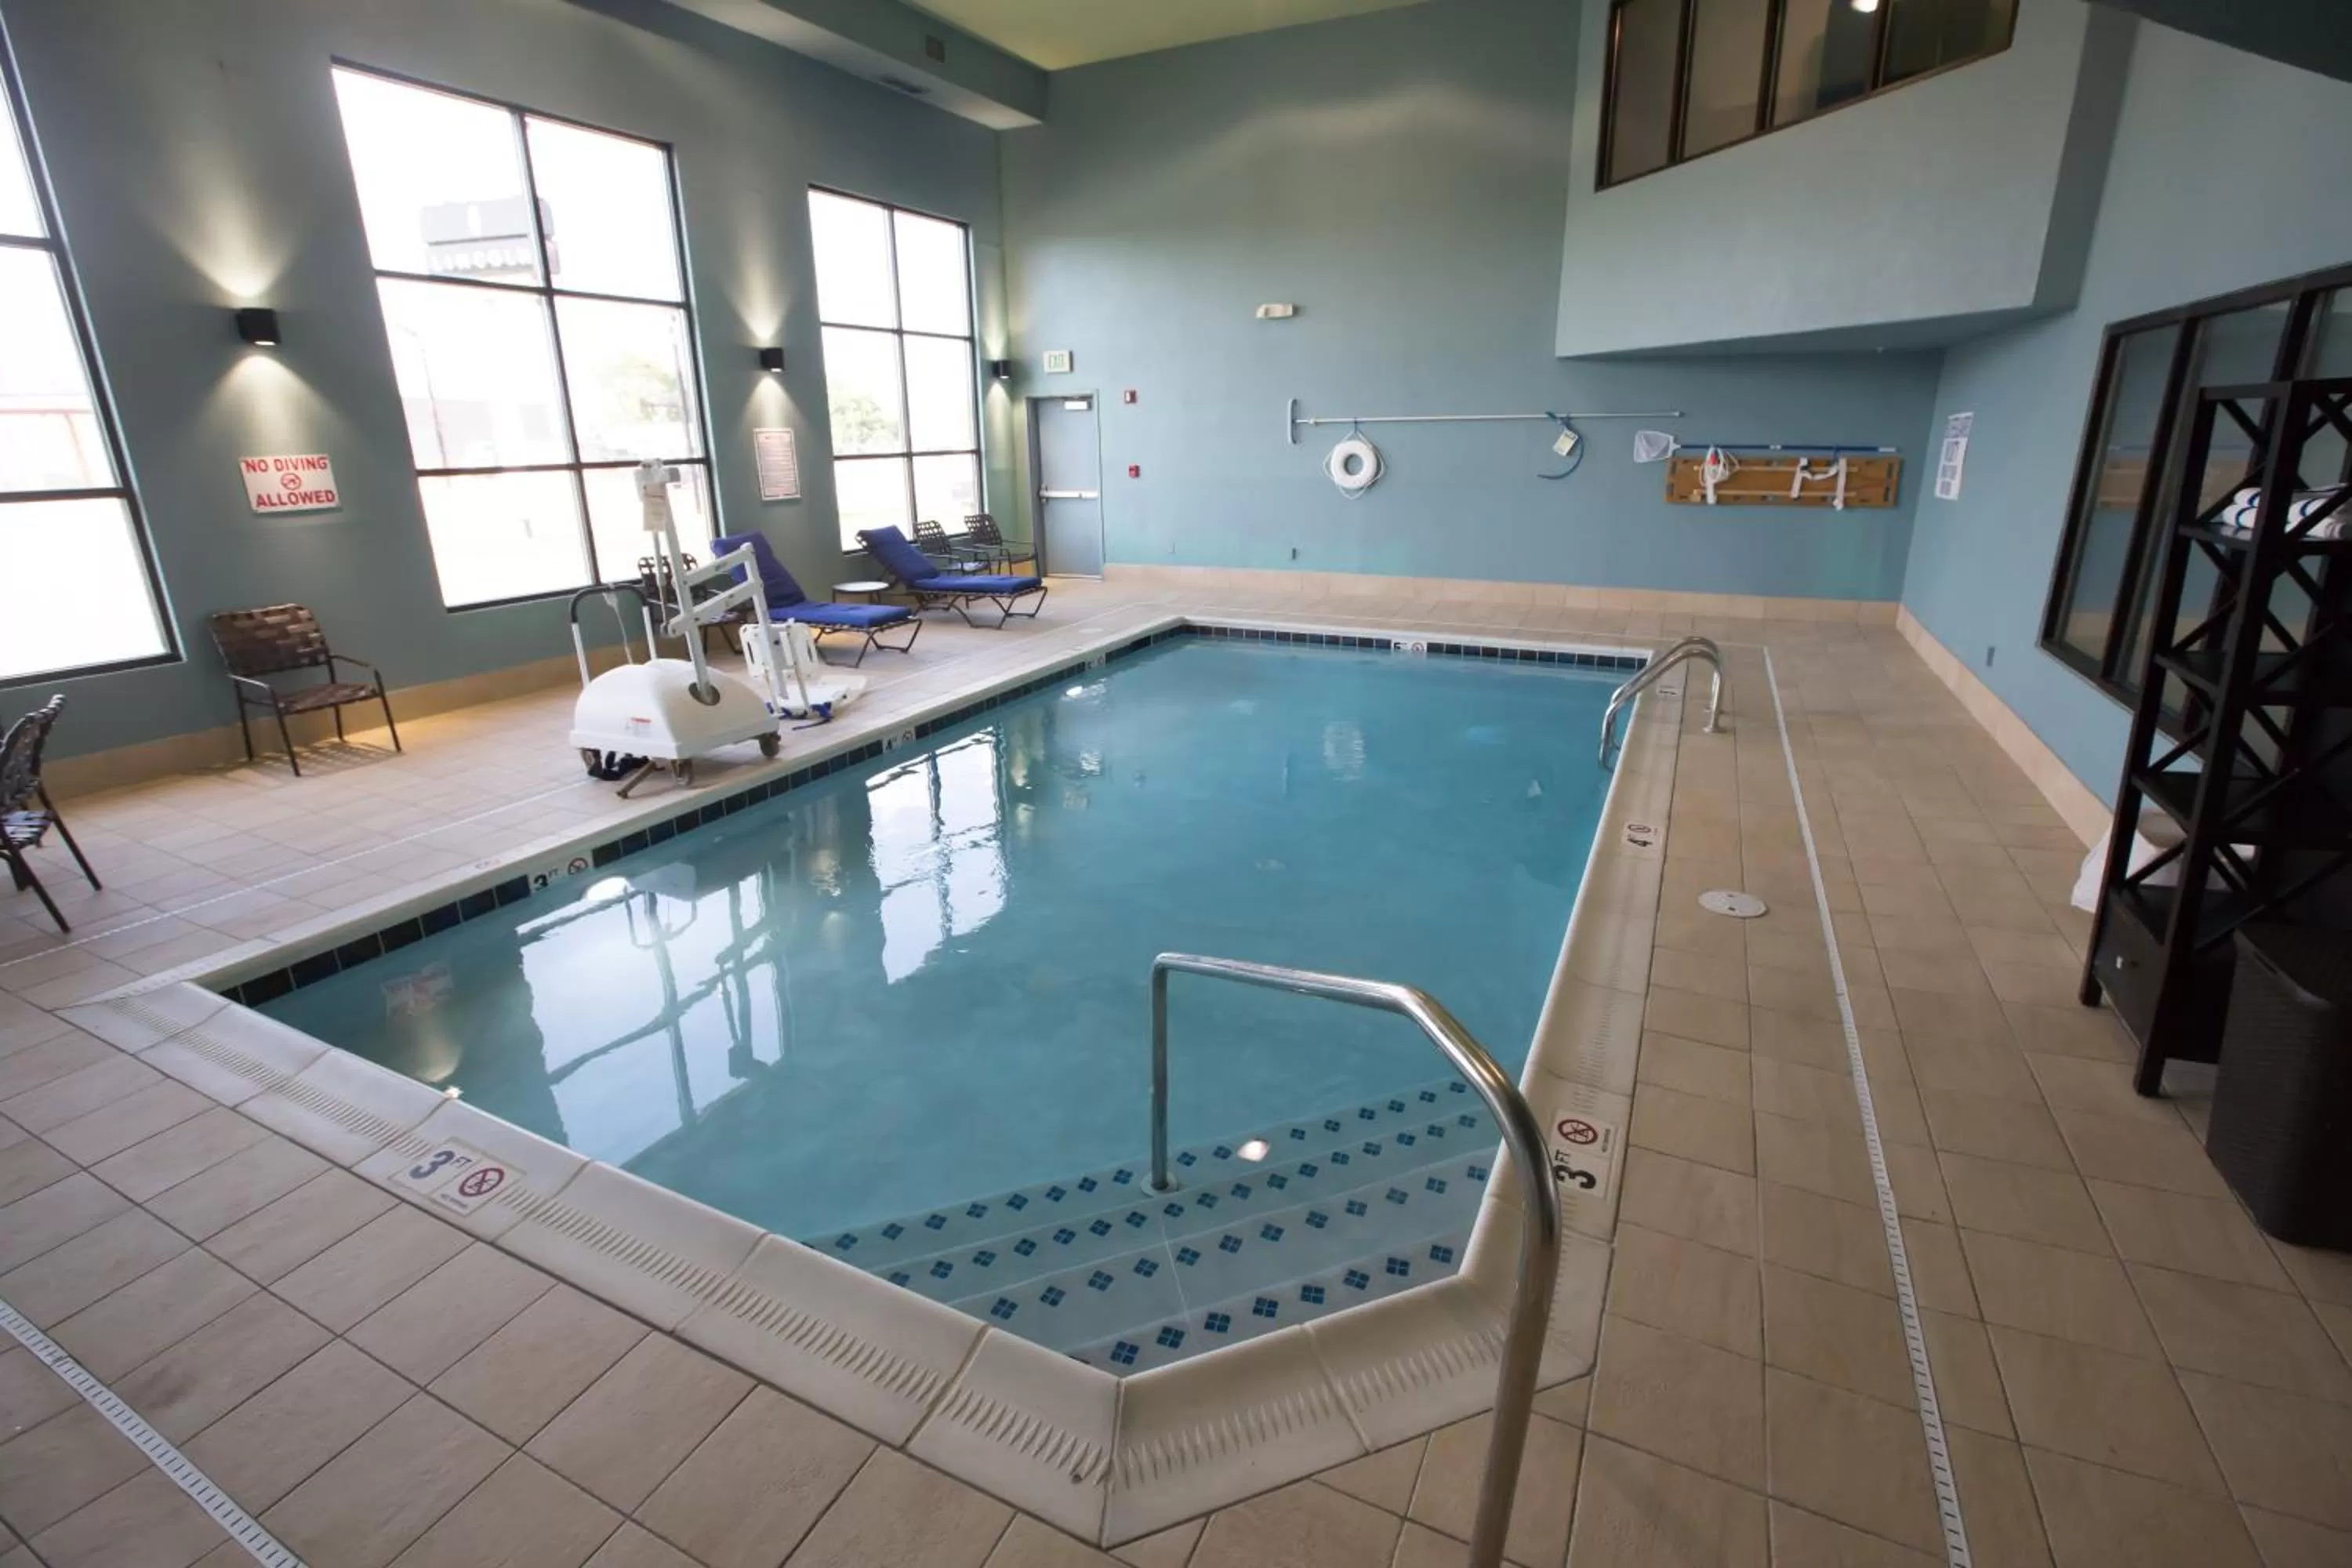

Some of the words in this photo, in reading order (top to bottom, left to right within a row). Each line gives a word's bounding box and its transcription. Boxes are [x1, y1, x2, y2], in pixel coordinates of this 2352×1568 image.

[244, 459, 268, 472] NO
[274, 456, 328, 471] DIVING
[256, 490, 336, 507] ALLOWED
[409, 1150, 456, 1180] 3
[450, 1156, 474, 1168] FT
[1555, 1149, 1571, 1164] FT
[1553, 1165, 1596, 1189] 3
